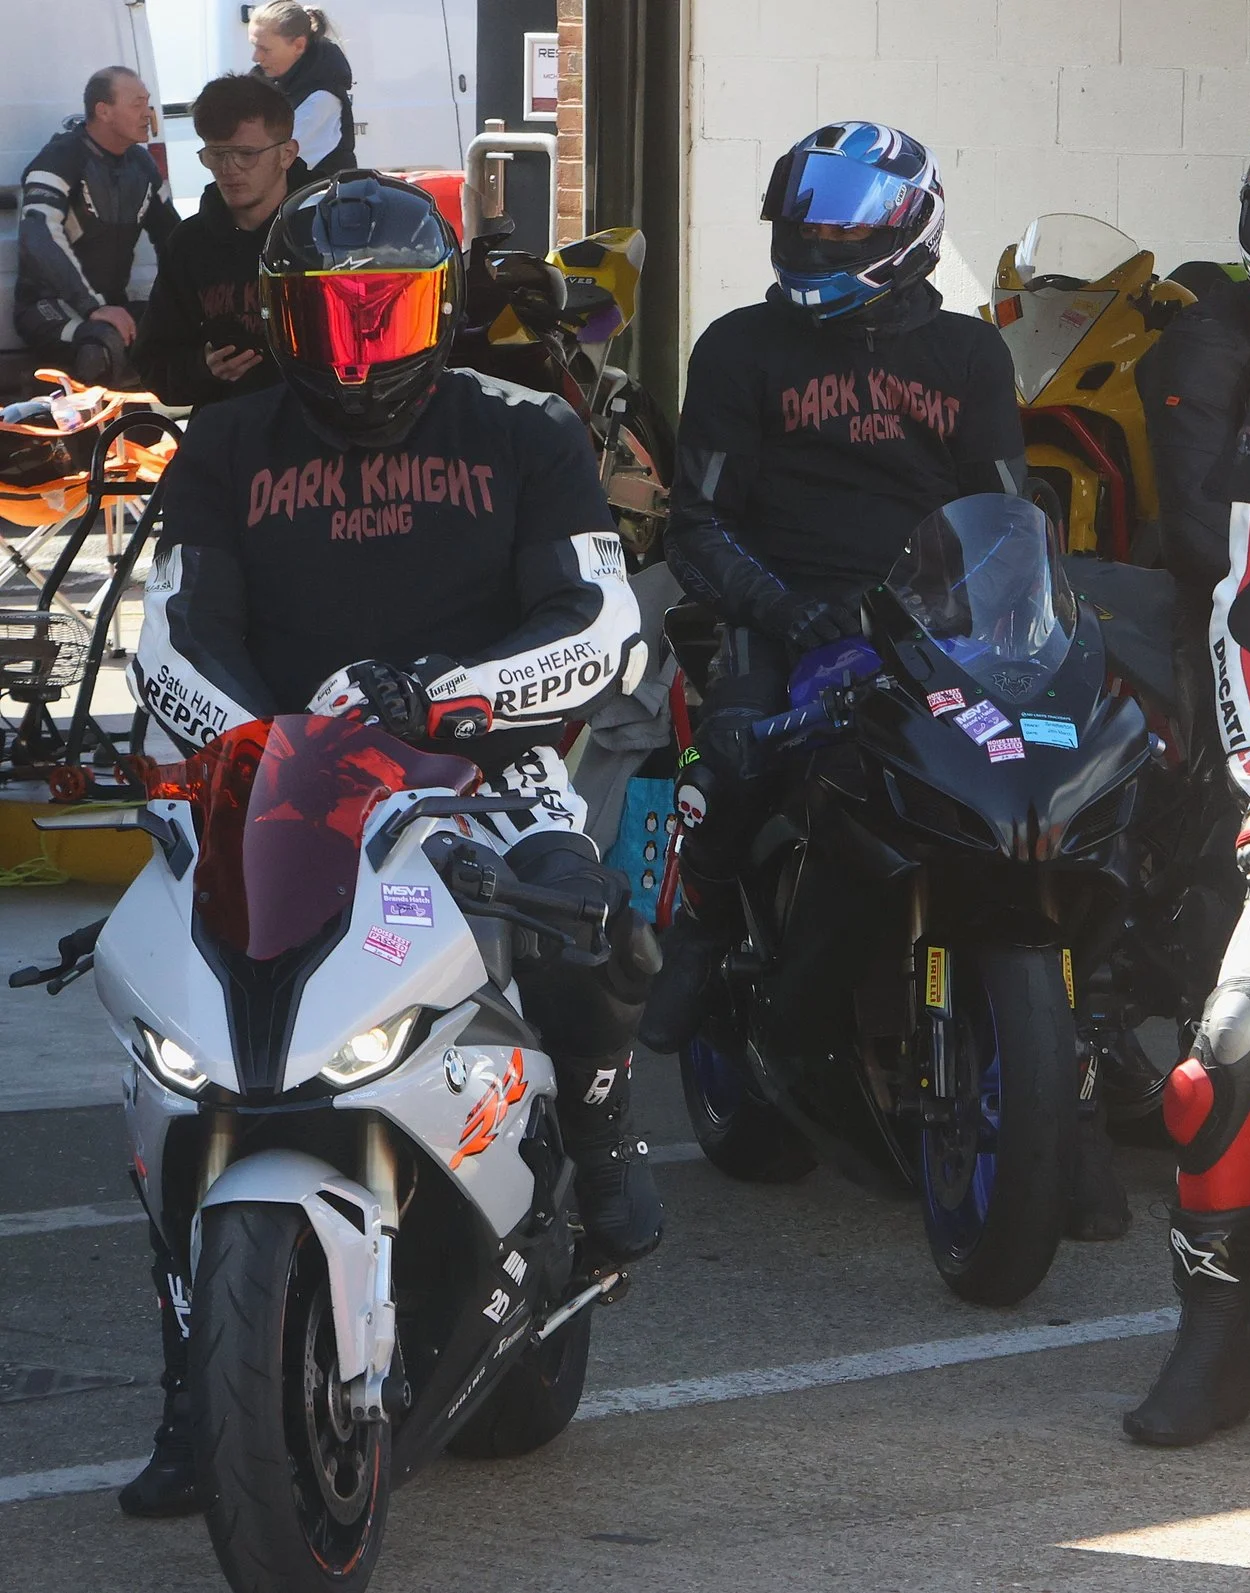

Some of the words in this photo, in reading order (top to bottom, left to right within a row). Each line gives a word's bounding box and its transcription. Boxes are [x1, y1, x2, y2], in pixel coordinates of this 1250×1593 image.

[782, 373, 859, 432] DARK
[247, 454, 346, 528] DARK
[360, 452, 494, 519] KNIGHT
[330, 503, 413, 544] RACING
[157, 664, 188, 698] Satu
[499, 663, 535, 685] One
[537, 641, 602, 673] HEART.
[494, 652, 614, 713] REPSOL
[926, 691, 943, 700] NOISE
[1213, 636, 1247, 750] DUCATI
[144, 677, 219, 746] REPSO
[955, 700, 989, 724] MSVT
[988, 743, 1023, 752] PASSED
[382, 884, 429, 897] MSVT
[383, 895, 409, 903] Brands
[409, 896, 430, 904] Hatch
[369, 930, 408, 953] PASSED
[371, 925, 392, 938] NOISE
[392, 934, 411, 946] TEST
[931, 951, 941, 1003] PIRELLI
